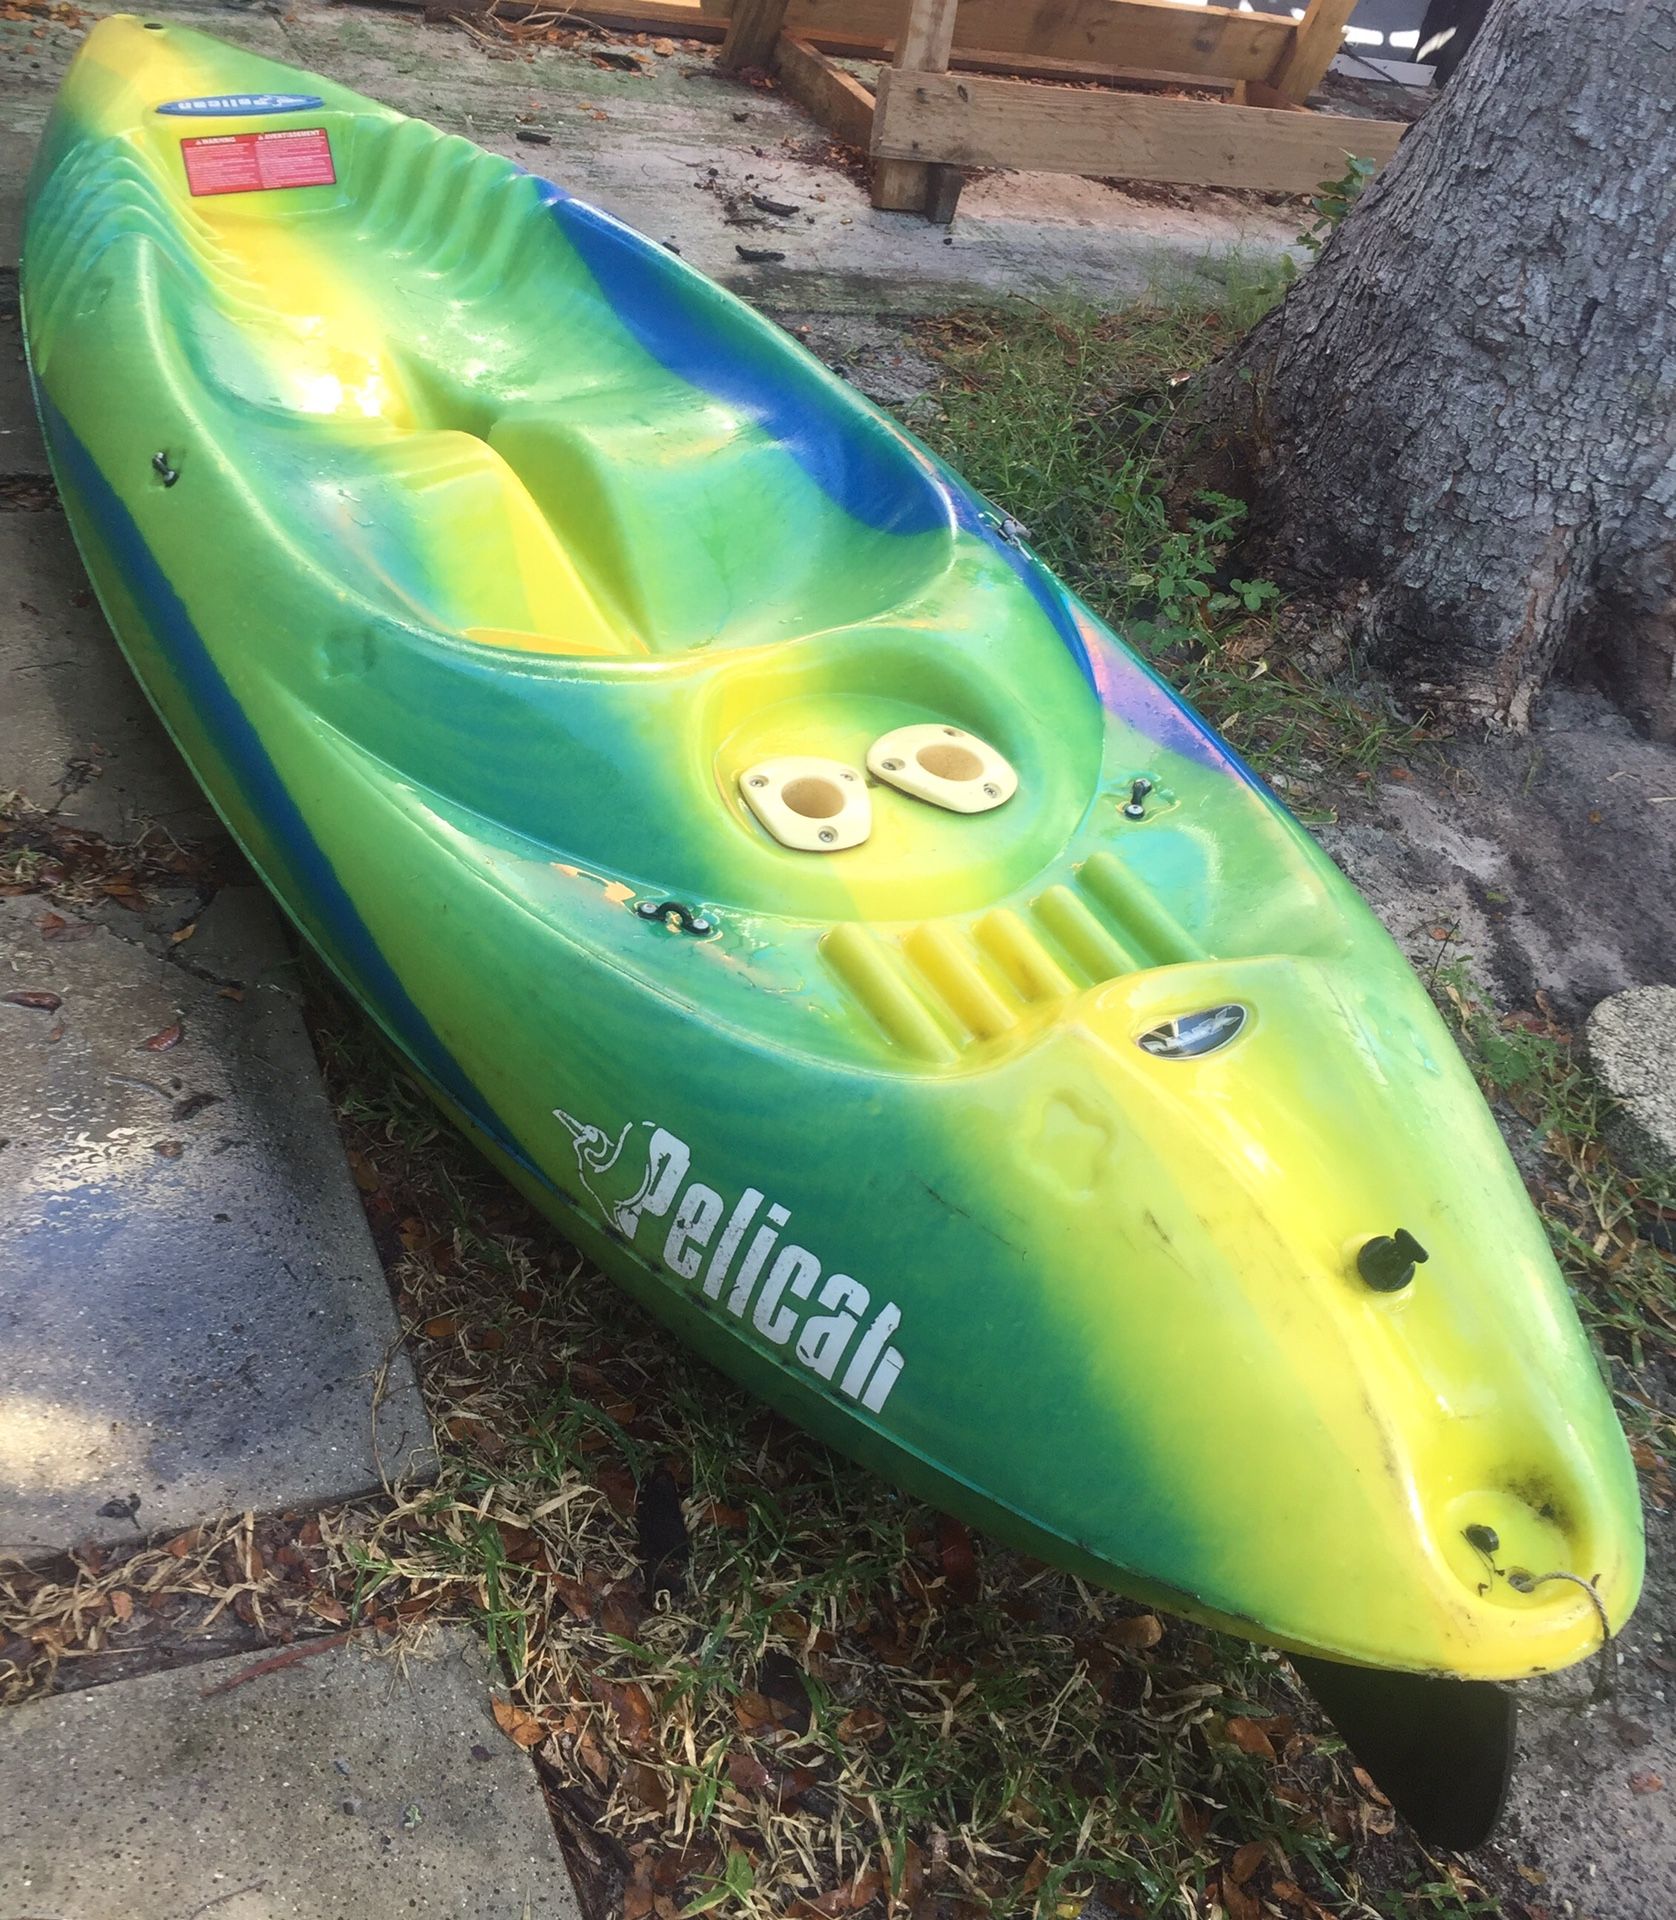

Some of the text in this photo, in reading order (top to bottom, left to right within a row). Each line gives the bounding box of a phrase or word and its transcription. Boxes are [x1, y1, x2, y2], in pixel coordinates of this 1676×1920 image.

[178, 97, 268, 110] Pelican
[201, 136, 236, 145] WARNING
[615, 1127, 905, 1414] Pelican
